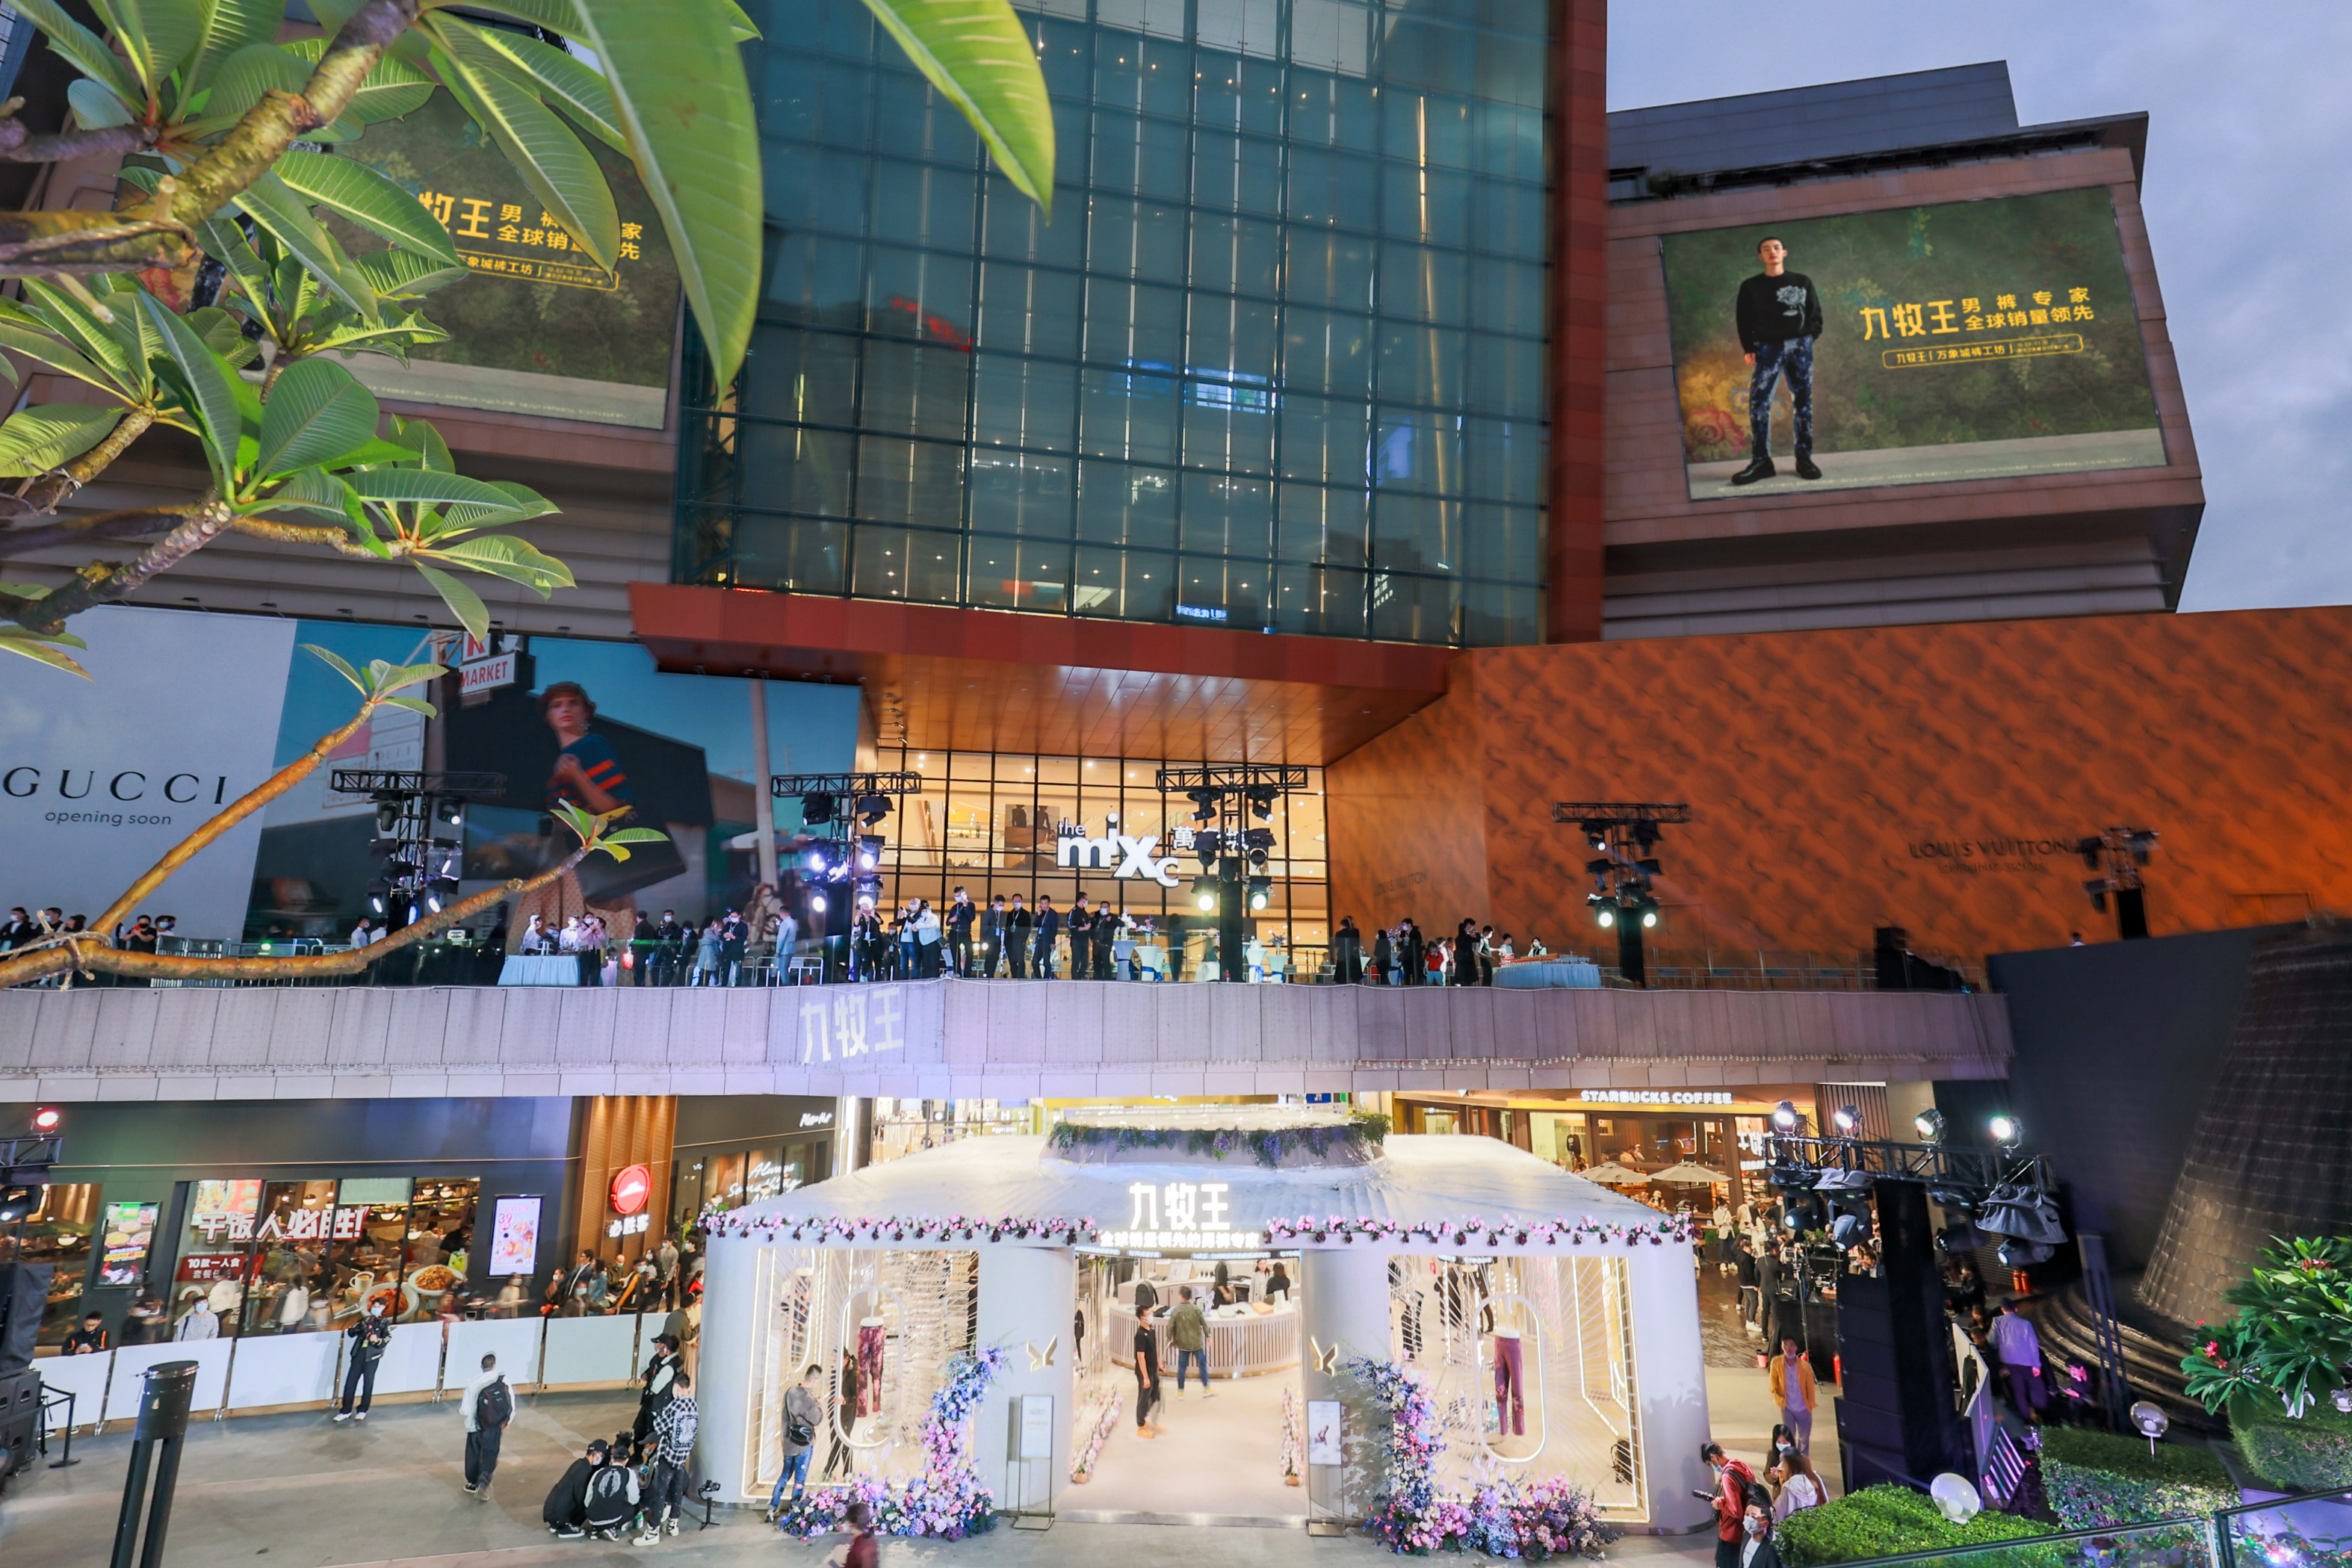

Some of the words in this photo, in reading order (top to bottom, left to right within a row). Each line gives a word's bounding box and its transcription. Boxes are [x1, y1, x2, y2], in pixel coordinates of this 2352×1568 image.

[418, 191, 493, 239] 牧王
[497, 224, 640, 260] 全球销先
[1860, 300, 1959, 340] 九牧王
[1964, 305, 2094, 331] 全球销量领先
[460, 661, 508, 687] MARKET
[3, 766, 227, 805] GUCCI
[45, 811, 123, 827] opening
[129, 814, 172, 825] soon
[1058, 817, 1086, 836] the
[1908, 841, 1974, 859] LOUIS
[1976, 839, 2070, 856] VUITTON
[799, 987, 905, 1065] 九牧王
[1581, 1090, 1670, 1104] STARBUCKS
[1672, 1091, 1733, 1105] COFFEE
[1129, 1182, 1231, 1231] 九牧王
[608, 1213, 650, 1238] 必胜客
[188, 1257, 241, 1268] 10款一人食
